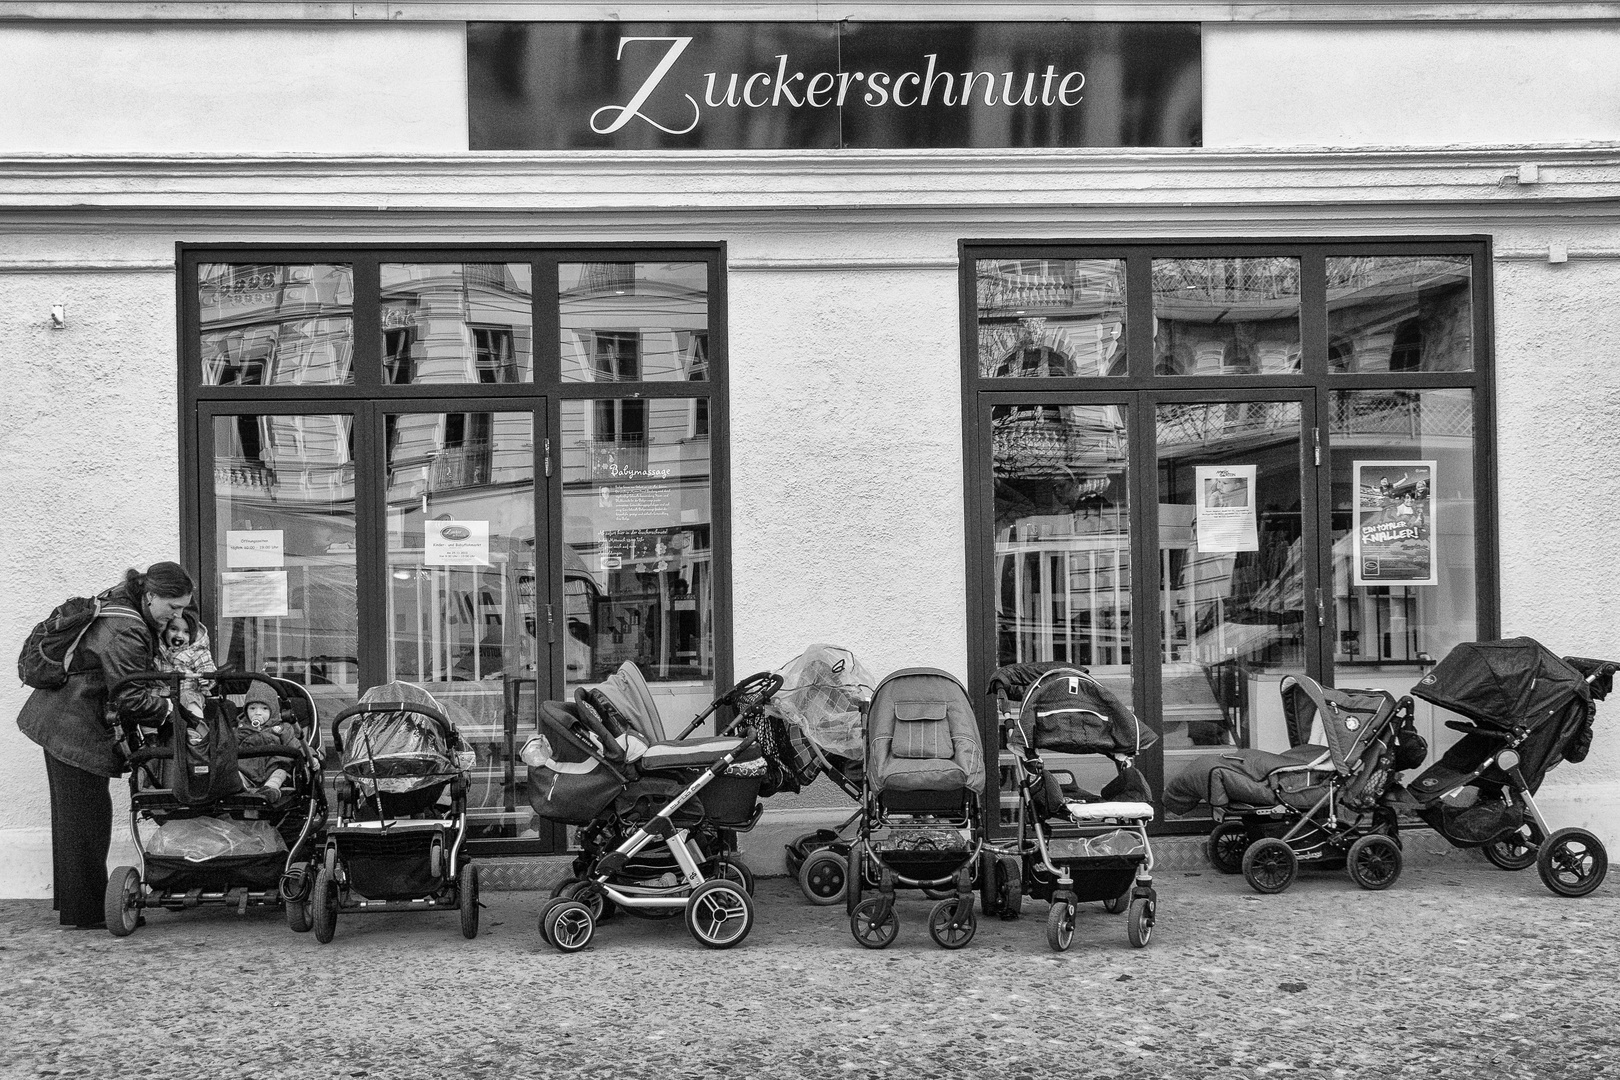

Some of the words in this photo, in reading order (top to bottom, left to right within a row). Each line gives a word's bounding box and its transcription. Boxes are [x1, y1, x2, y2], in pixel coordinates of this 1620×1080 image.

[590, 36, 1087, 135] Zuckerschnute
[609, 463, 671, 479] Babymassage
[1361, 526, 1419, 544] KNALLER!
[1362, 526, 1377, 534] EIN
